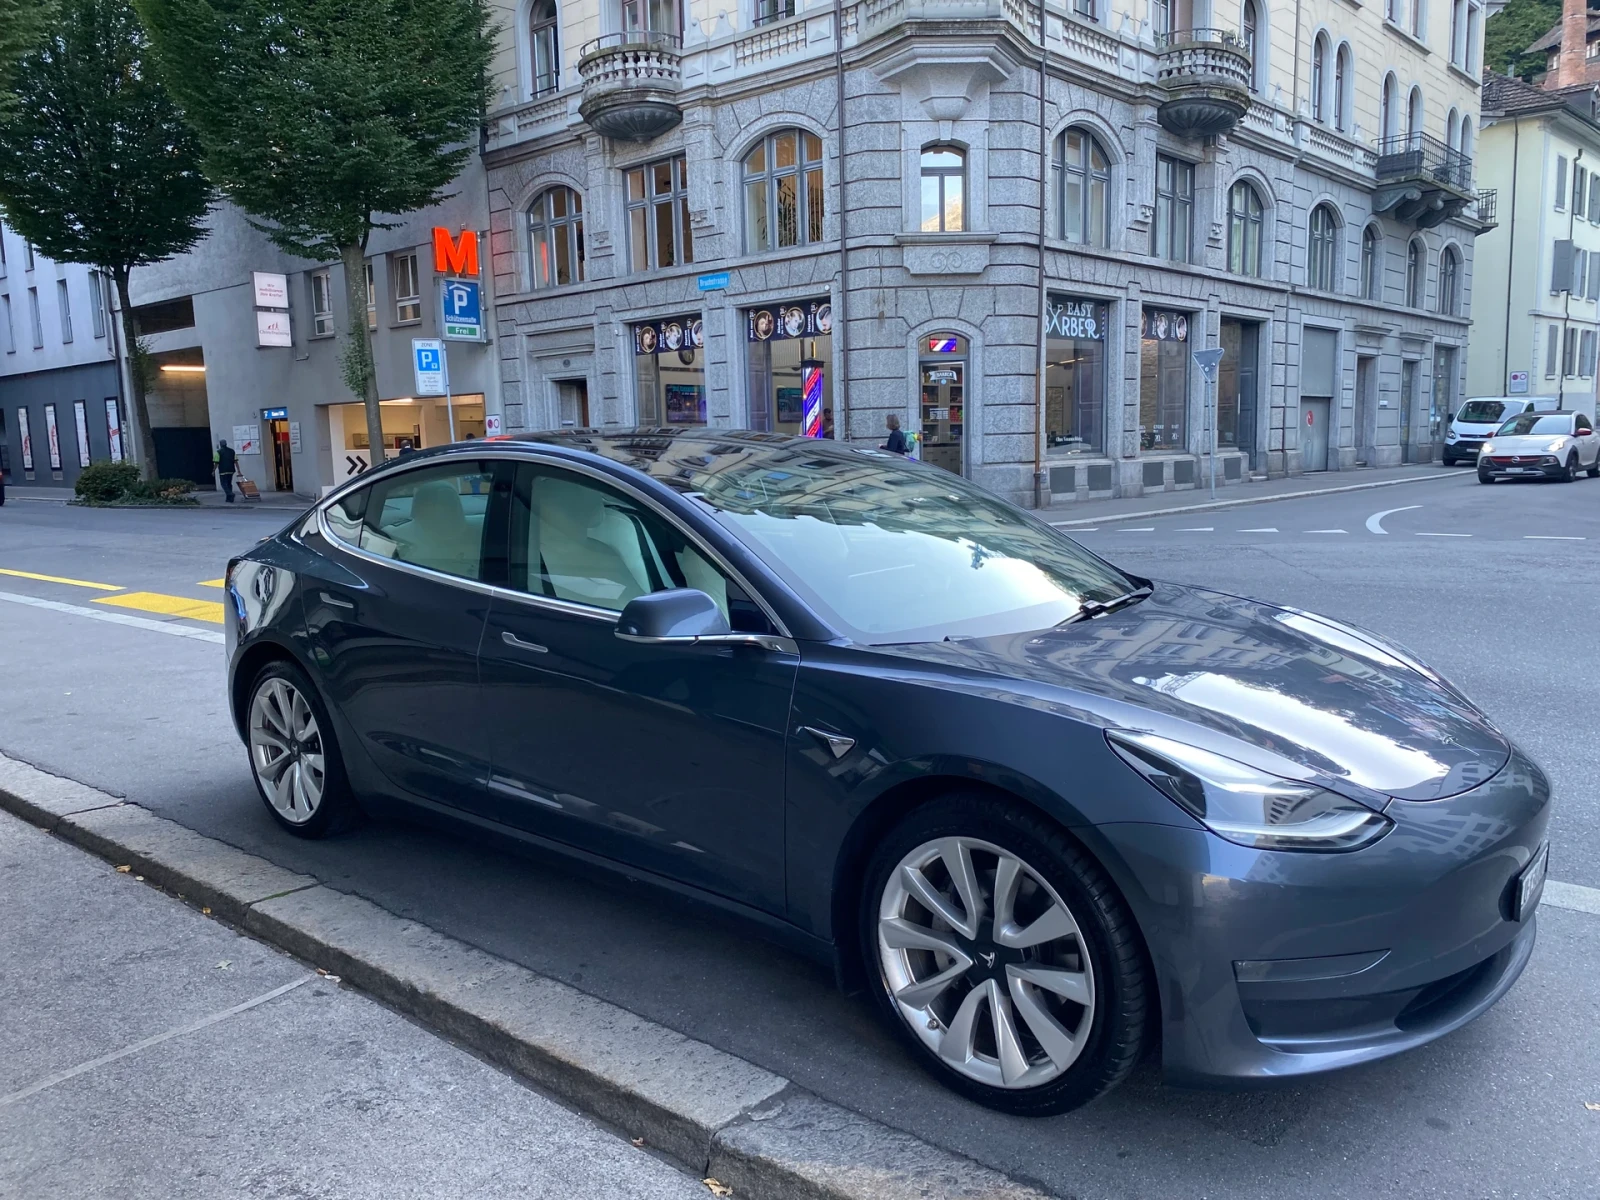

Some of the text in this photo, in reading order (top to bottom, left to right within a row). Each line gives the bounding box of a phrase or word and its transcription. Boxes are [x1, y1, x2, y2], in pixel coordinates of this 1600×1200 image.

[432, 227, 478, 275] M
[453, 289, 468, 315] P
[1066, 302, 1094, 317] EASY
[445, 314, 477, 324] Schützenmatte
[455, 327, 470, 336] Frei
[421, 351, 432, 368] P
